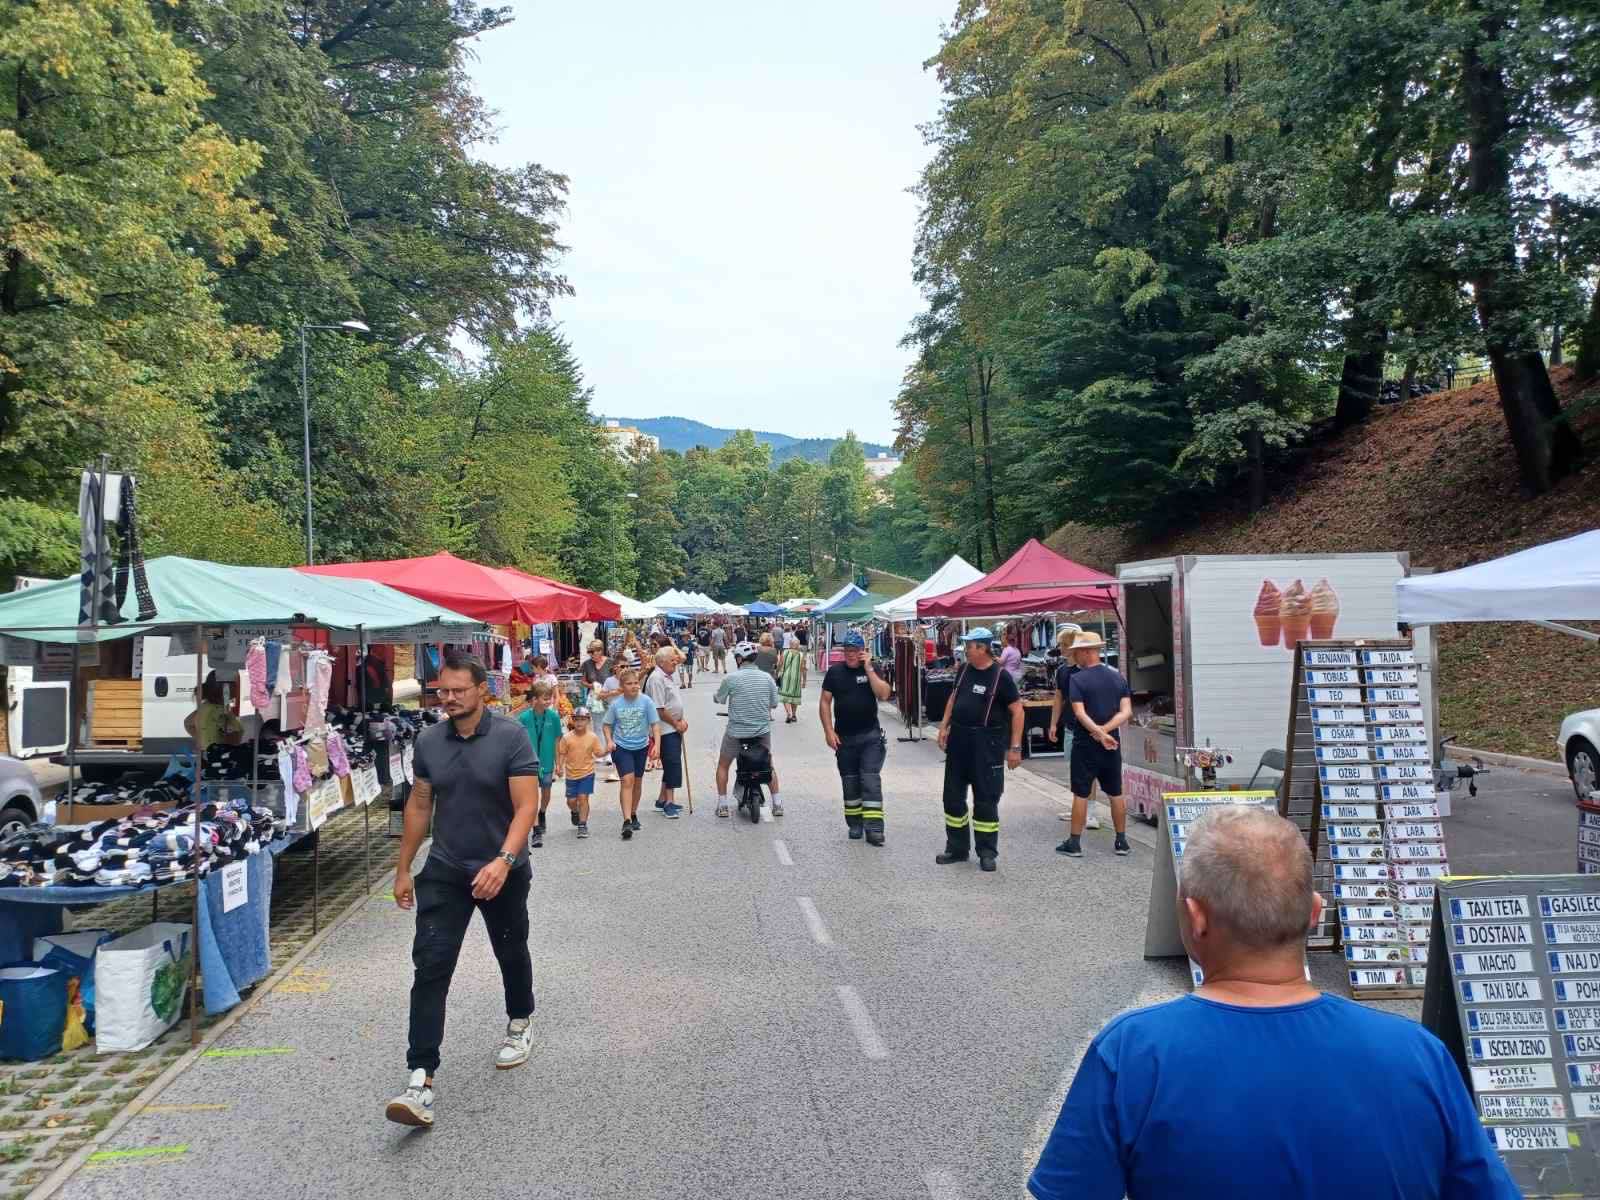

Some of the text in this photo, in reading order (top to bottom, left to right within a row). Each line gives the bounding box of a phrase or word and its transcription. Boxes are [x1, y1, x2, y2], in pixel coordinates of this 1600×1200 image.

[1316, 652, 1351, 664] BENJAMIN
[1379, 653, 1402, 663] TAJDA
[1322, 672, 1349, 682] TOBIAS
[1328, 690, 1343, 700] TEO
[1333, 710, 1344, 721] TIT
[1388, 710, 1410, 719] NENA
[1331, 728, 1354, 739] OSKAR
[1389, 728, 1410, 739] LARA
[1392, 747, 1415, 758] NADA
[1398, 767, 1417, 778] ZALA
[1402, 786, 1419, 797] ANA
[1338, 806, 1358, 817] MIHA
[1340, 826, 1361, 837] MAKS
[1405, 826, 1426, 837] LARA
[1347, 847, 1360, 857] NIK
[1352, 867, 1367, 877] NIK
[1416, 867, 1430, 877] MIA
[1348, 886, 1368, 897] TOMI
[1356, 908, 1373, 919] TIM
[1467, 899, 1523, 917] TAXI TETA
[1469, 925, 1526, 944] DOSTAVA
[1477, 954, 1516, 972] MACHO
[1565, 952, 1600, 970] NAJ D
[1364, 971, 1387, 983] TIMI
[1482, 982, 1504, 1000] TAXI
[1576, 981, 1600, 999] POH
[1569, 1019, 1586, 1029] KOT
[1489, 1066, 1537, 1077] HOTEL
[1484, 1097, 1550, 1107] DAN BREZ PIVA
[1486, 1108, 1551, 1118] DAN BREZ SONCA
